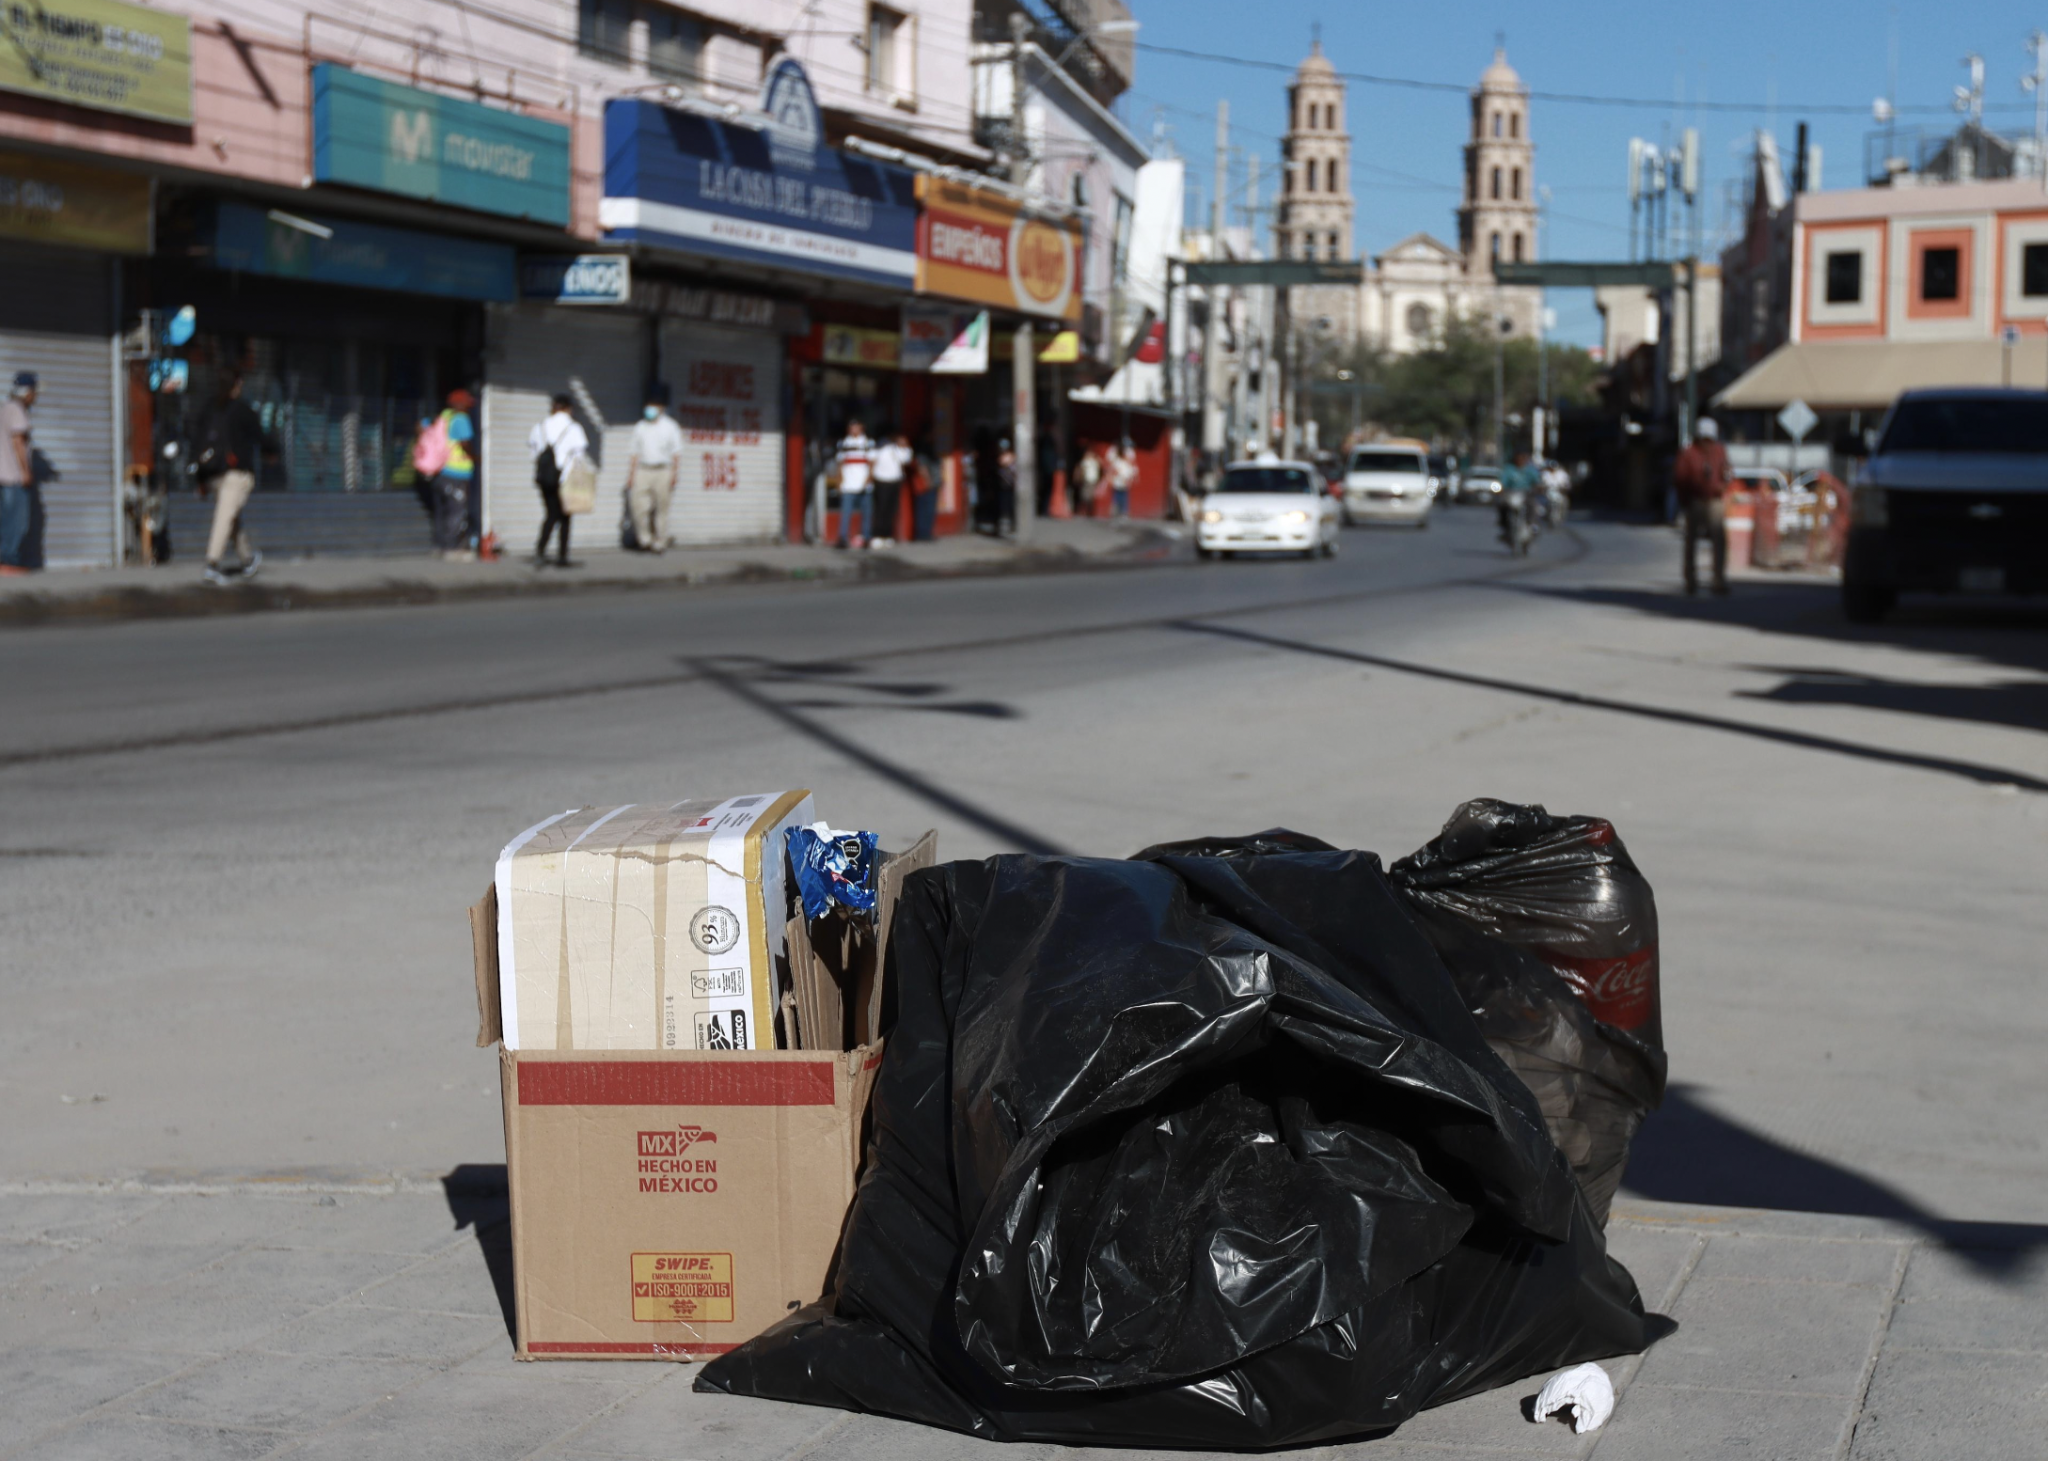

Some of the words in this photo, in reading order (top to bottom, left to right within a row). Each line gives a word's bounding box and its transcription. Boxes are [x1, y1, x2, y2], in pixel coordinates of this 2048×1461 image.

[443, 132, 535, 181] movistar
[930, 221, 1004, 272] EMPEÑOS
[701, 924, 719, 945] 93
[641, 1134, 675, 1154] MX
[637, 1159, 693, 1173] HECHO
[695, 1159, 717, 1173] EN
[638, 1174, 718, 1193] MÉXICO
[651, 1272, 677, 1280] EMPRESA
[677, 1272, 712, 1280] CERTIFICADA
[653, 1283, 728, 1297] ISO-9001:2015
